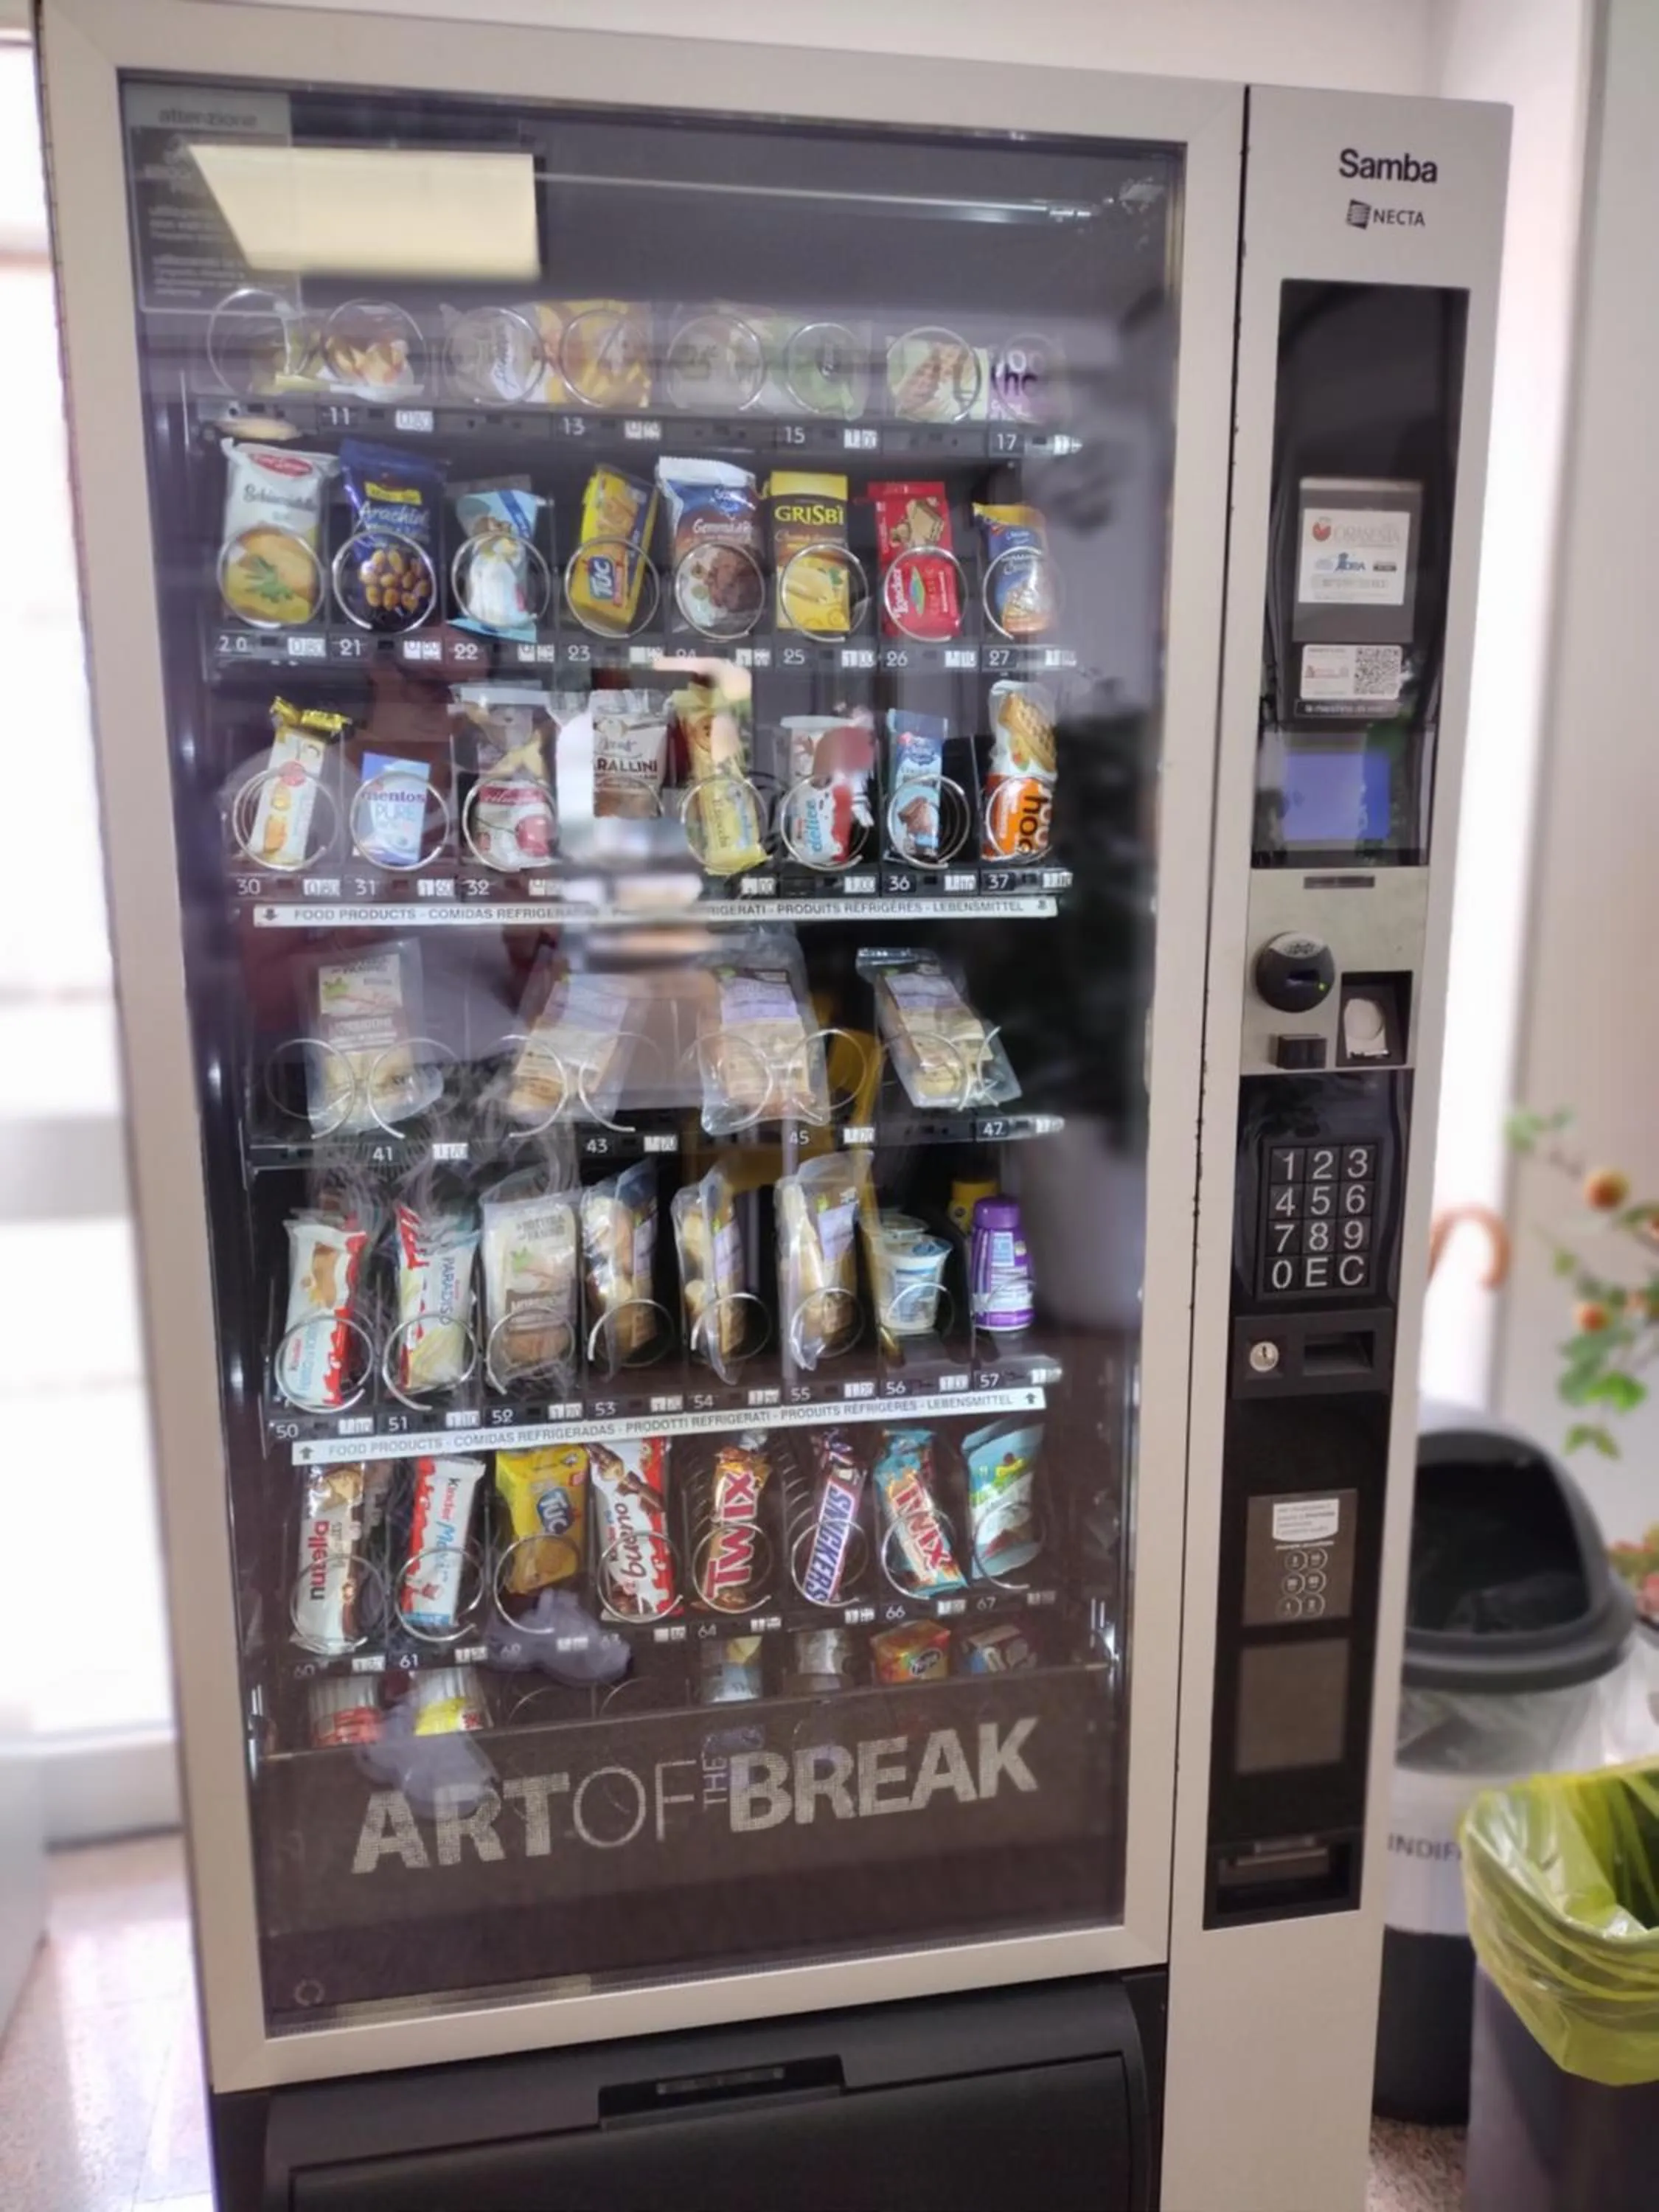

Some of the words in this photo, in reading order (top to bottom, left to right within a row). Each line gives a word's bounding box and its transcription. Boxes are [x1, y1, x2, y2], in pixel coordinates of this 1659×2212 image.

[1339, 147, 1439, 184] Samba
[1373, 209, 1426, 227] NECTA
[329, 408, 350, 425] 11
[562, 417, 585, 435] 13
[784, 426, 805, 443] 15
[997, 433, 1018, 451] 17
[592, 559, 613, 597] TUC
[219, 635, 248, 653] 20
[339, 641, 361, 657] 21
[453, 642, 479, 661] 22
[567, 644, 591, 662] 23
[783, 649, 806, 665] 25
[886, 651, 908, 667] 26
[988, 651, 1009, 667] 27
[597, 758, 658, 773] RALLINI
[360, 789, 426, 803] mentos
[237, 878, 261, 896] 30
[355, 879, 376, 896] 31
[466, 878, 490, 896] 32
[888, 874, 911, 891] 36
[987, 873, 1009, 891] 37
[294, 908, 334, 921] FOOD
[339, 907, 417, 921] PRODUCTS
[428, 907, 494, 920] COMIDAS
[776, 902, 841, 916] PRODUITS
[933, 900, 1024, 914] LEBENSMITTEL
[789, 1130, 810, 1146] 45
[984, 1121, 1004, 1137] 47
[372, 1147, 394, 1162] 41
[586, 1138, 609, 1154] 43
[1282, 1151, 1295, 1180] 1
[1312, 1150, 1334, 1180] 2
[1347, 1148, 1368, 1178] 3
[1275, 1186, 1295, 1217] 4
[1310, 1186, 1331, 1215] 5
[1346, 1184, 1366, 1214] 6
[1273, 1224, 1295, 1253] 7
[1309, 1221, 1329, 1251] 8
[1343, 1220, 1363, 1251] 9
[1271, 1259, 1293, 1290] 0
[1305, 1256, 1329, 1288] E
[1338, 1255, 1364, 1286] C
[885, 1380, 907, 1396] 56
[979, 1372, 1001, 1389] 57
[693, 1394, 714, 1410] 54
[790, 1387, 811, 1402] 55
[491, 1408, 515, 1425] 52
[594, 1402, 616, 1416] 53
[275, 1423, 299, 1441] 50
[327, 1442, 367, 1457] FOOD
[370, 1438, 443, 1454] PRODUCTS
[453, 1432, 516, 1448] COMIDAS
[518, 1425, 615, 1444] REFRIGERADAS
[625, 1417, 689, 1433] PRODOTTI
[691, 1410, 771, 1428] REFRIGERATI
[780, 1404, 841, 1422] PRODUITS
[927, 1396, 1013, 1411] LEBENSMITTEL
[389, 1416, 408, 1432] 51
[538, 1489, 569, 1534] TUC
[703, 1471, 757, 1601] TWIX
[894, 1483, 953, 1571] TWIX
[613, 1501, 647, 1579] bueno
[804, 1484, 852, 1603] SNICKERS
[307, 1520, 330, 1601] nutella
[885, 1604, 906, 1621] 66
[975, 1596, 996, 1612] 67
[697, 1624, 718, 1639] 64
[399, 1653, 419, 1670] 61
[351, 1771, 571, 1874] ART
[572, 1759, 698, 1848] OF
[703, 1756, 728, 1812] THE
[728, 1717, 1040, 1833] BREAK
[1387, 1832, 1463, 1862] INDIF
